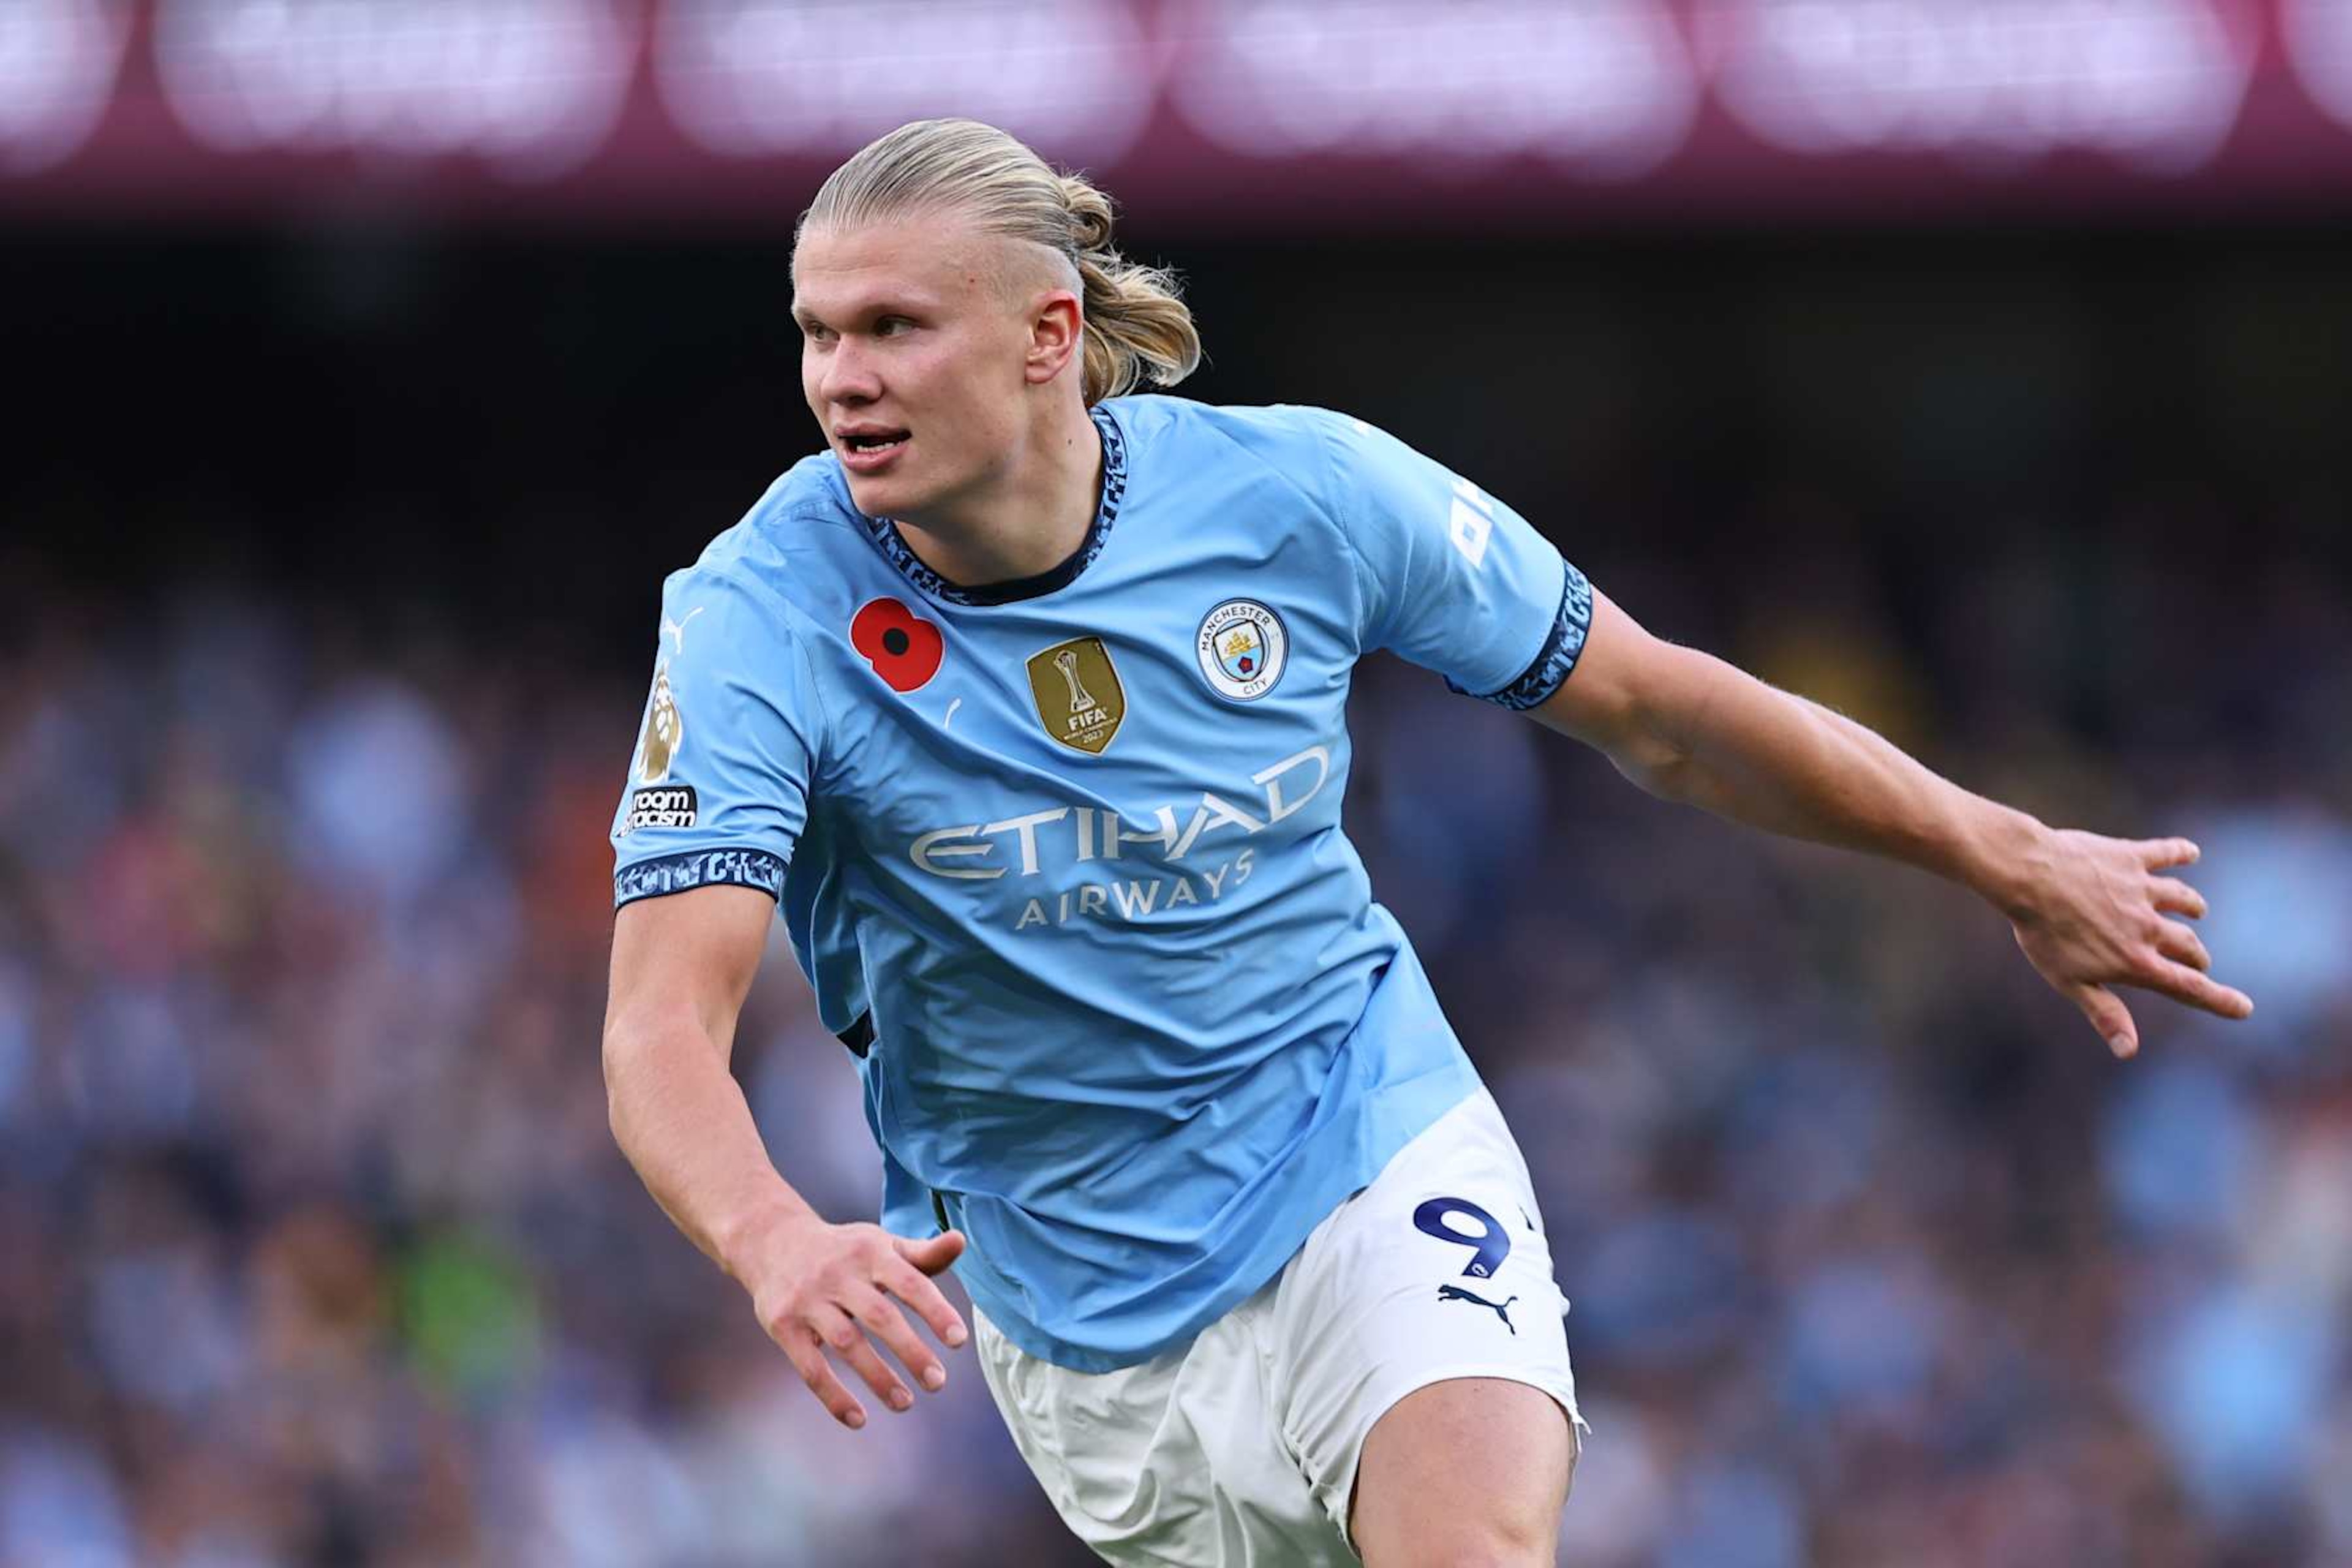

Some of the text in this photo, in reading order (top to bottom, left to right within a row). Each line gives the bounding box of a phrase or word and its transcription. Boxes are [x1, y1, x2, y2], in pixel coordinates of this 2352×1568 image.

[1202, 606, 1270, 651] MANCHESTER
[1243, 677, 1267, 695] CITY
[1068, 708, 1107, 732] FIFA
[633, 791, 689, 810] room
[910, 745, 1329, 879] ETIHAD
[1015, 848, 1255, 930] AIRWAYS
[1413, 1197, 1511, 1279] 9
